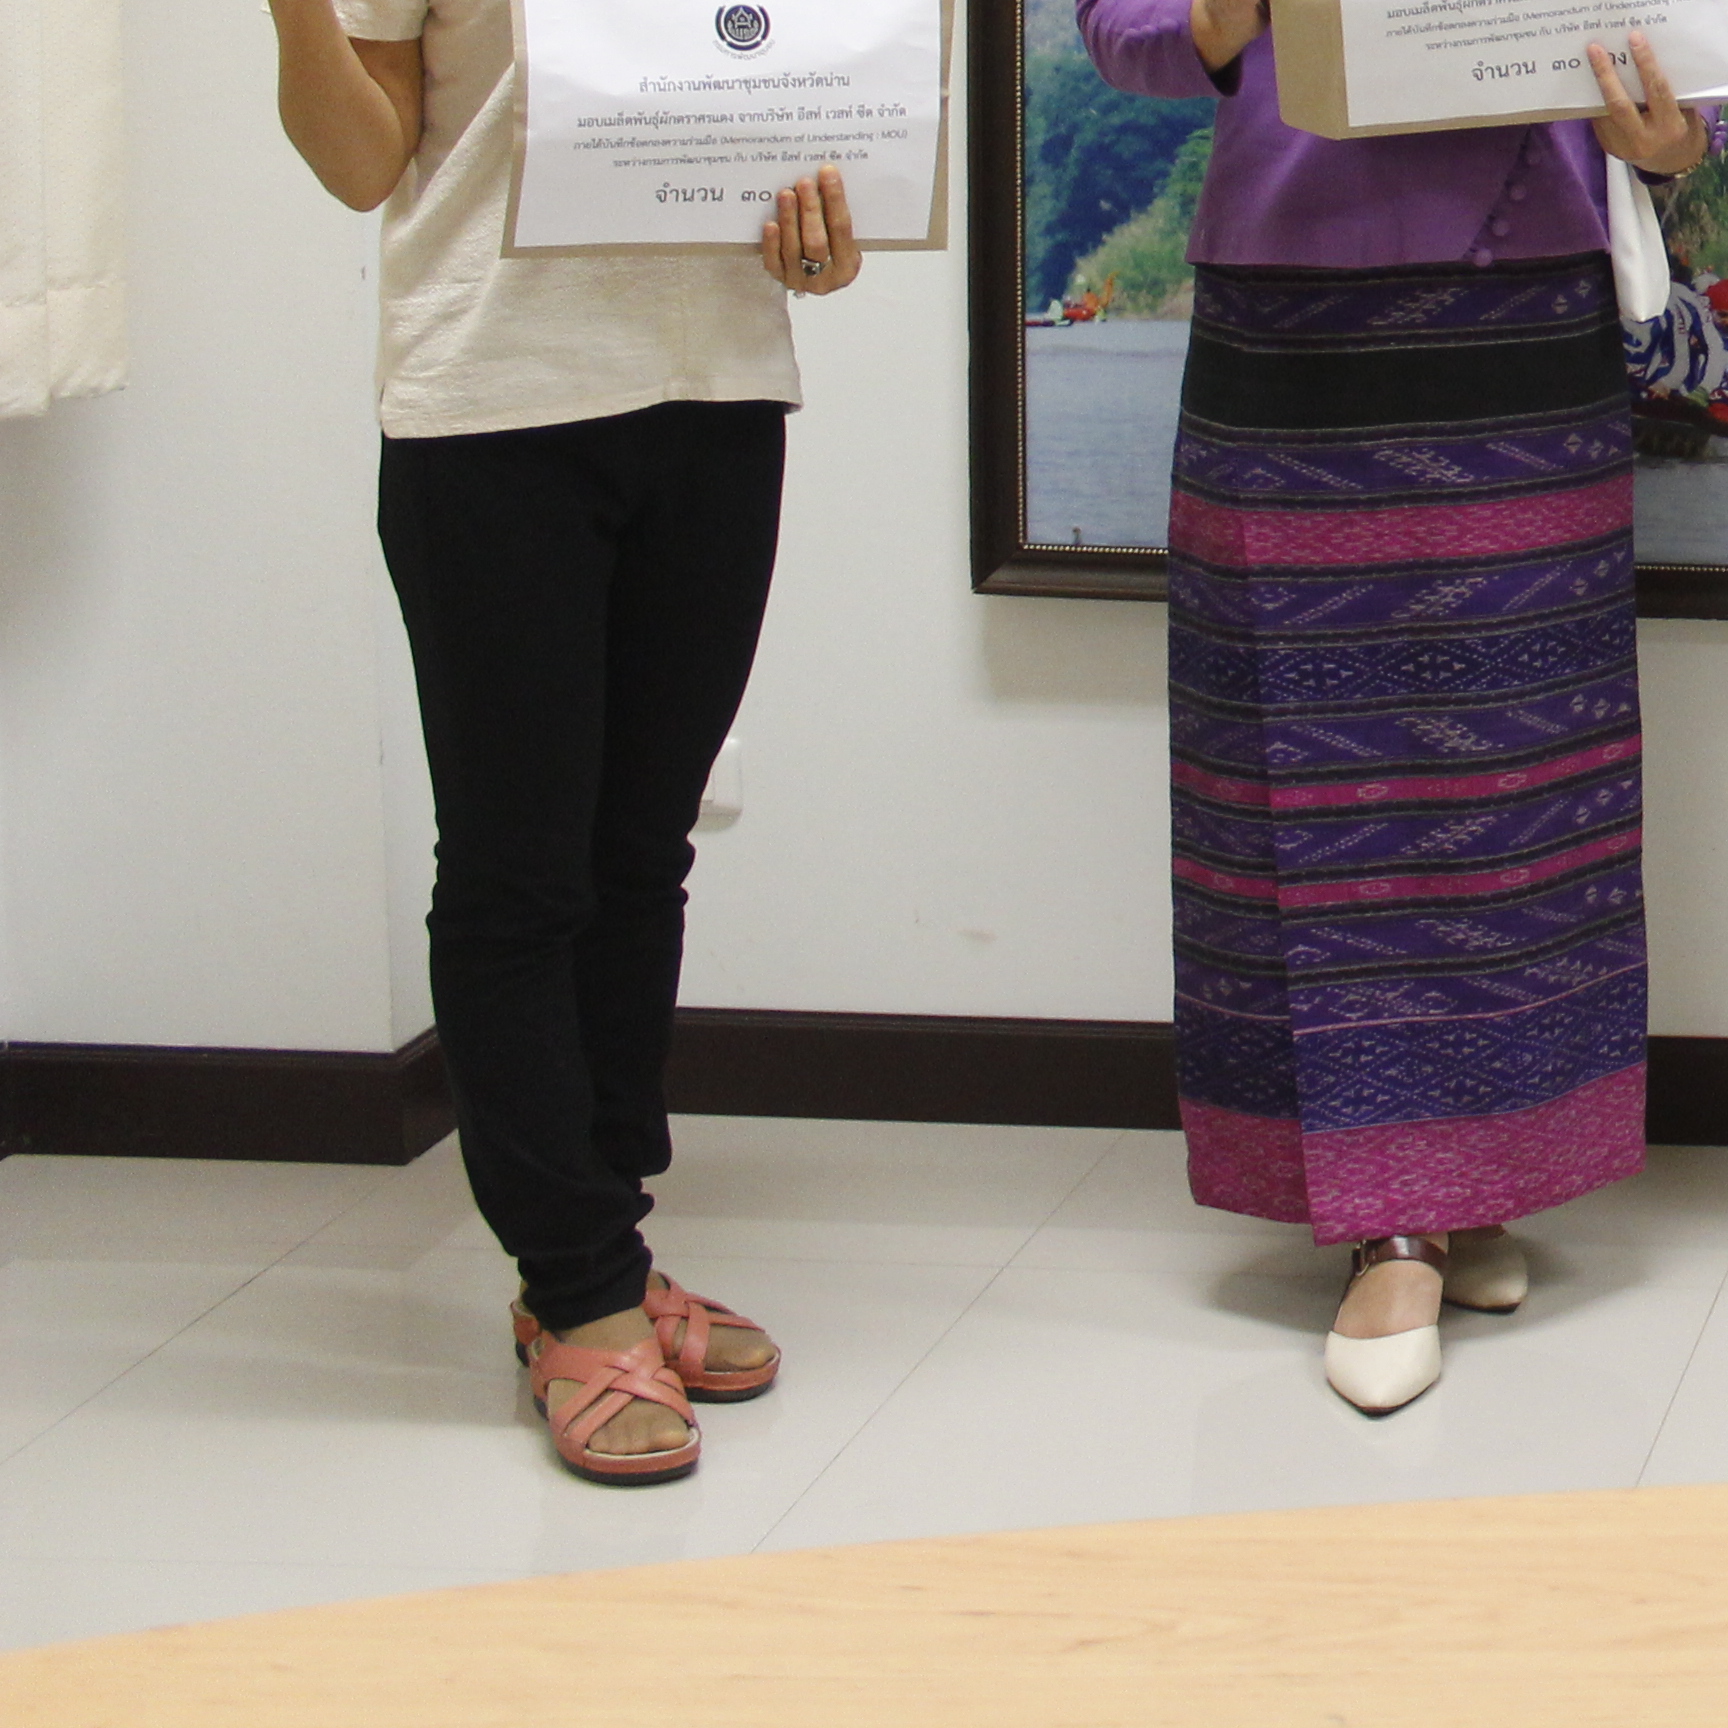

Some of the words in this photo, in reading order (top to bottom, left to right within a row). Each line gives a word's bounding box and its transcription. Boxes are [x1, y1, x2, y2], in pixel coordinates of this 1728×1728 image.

[1593, 3, 1603, 12] of
[1471, 59, 1537, 81] จำนวน
[1551, 56, 1581, 71] ๓๐
[639, 72, 850, 95] สำนักงานพัฒนาชุมชนจังหวัดน่าน
[738, 107, 793, 123] จากบริษัท
[877, 103, 907, 118] จำกัด
[795, 133, 805, 142] of
[655, 183, 724, 205] จำนวน
[741, 189, 772, 202] ๓๐
